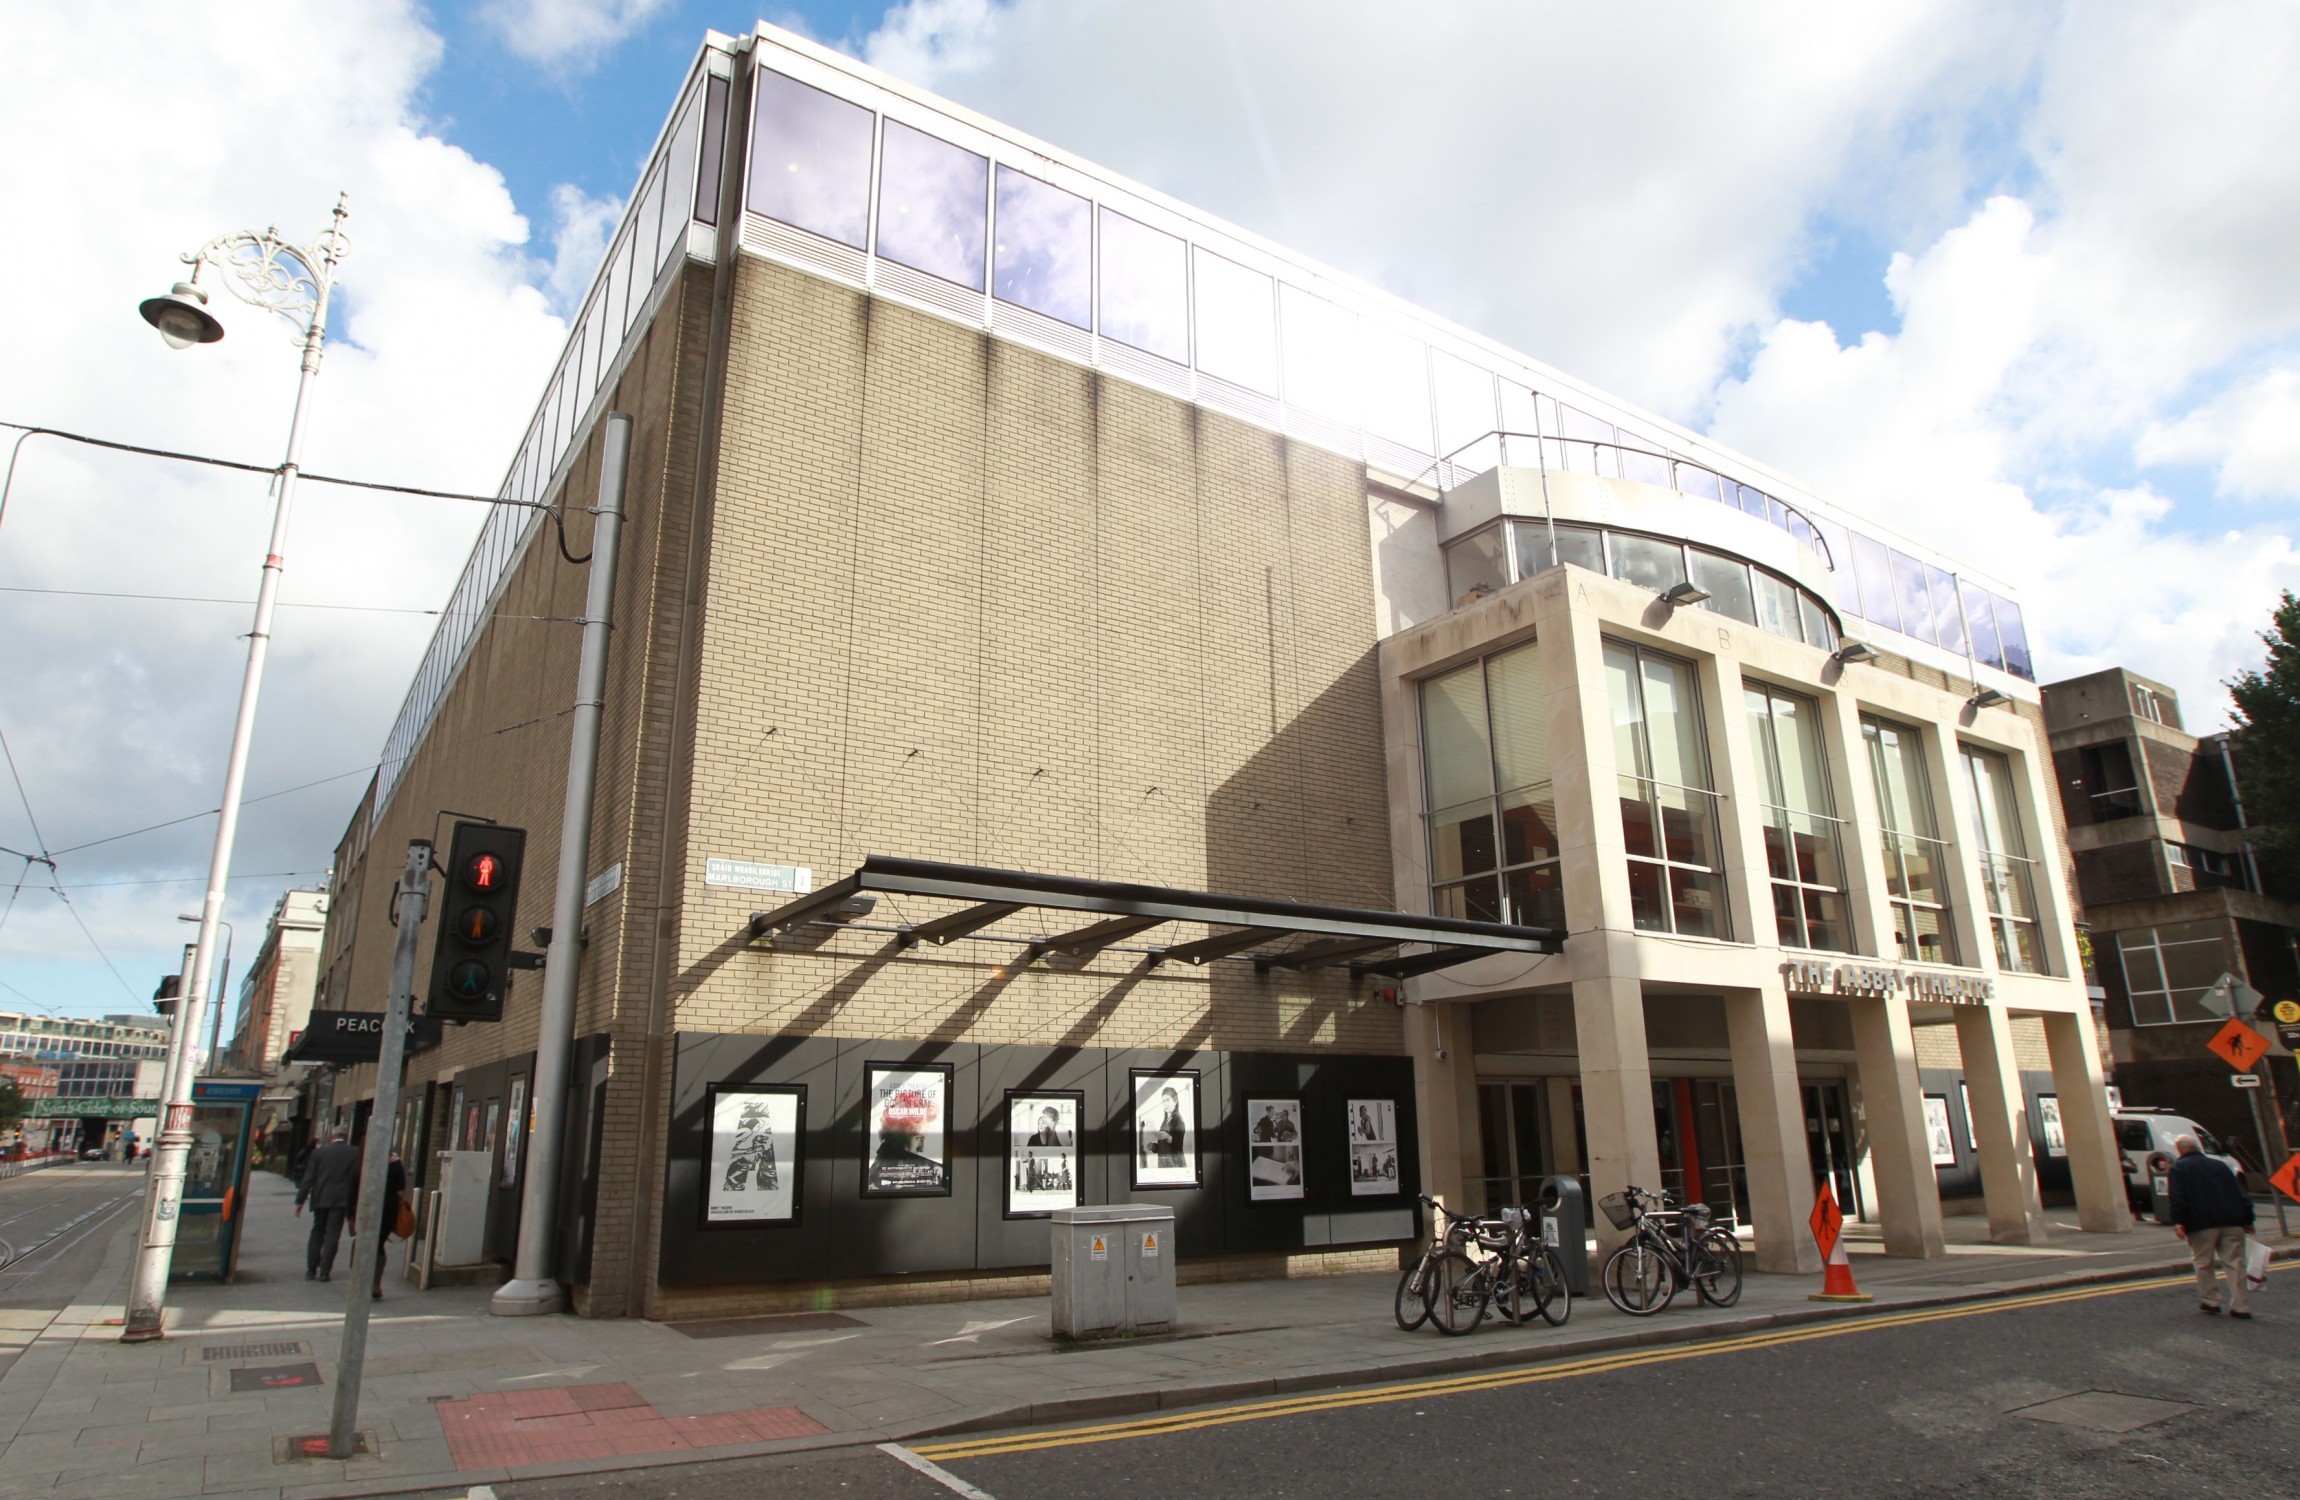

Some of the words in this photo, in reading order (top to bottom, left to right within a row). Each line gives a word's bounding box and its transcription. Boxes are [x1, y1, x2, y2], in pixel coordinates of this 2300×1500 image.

[707, 872, 778, 887] MARLBOROUGH
[1790, 958, 1832, 986] THE
[1841, 963, 1906, 991] ABBEY
[1912, 971, 1995, 999] THEATRE
[336, 1017, 416, 1034] PEACK
[879, 1088, 893, 1098] THE
[895, 1089, 926, 1099] PICTURE
[927, 1089, 937, 1099] OF
[913, 1099, 932, 1108] GRAY
[888, 1107, 908, 1116] OSCAR
[909, 1107, 928, 1116] WILDE
